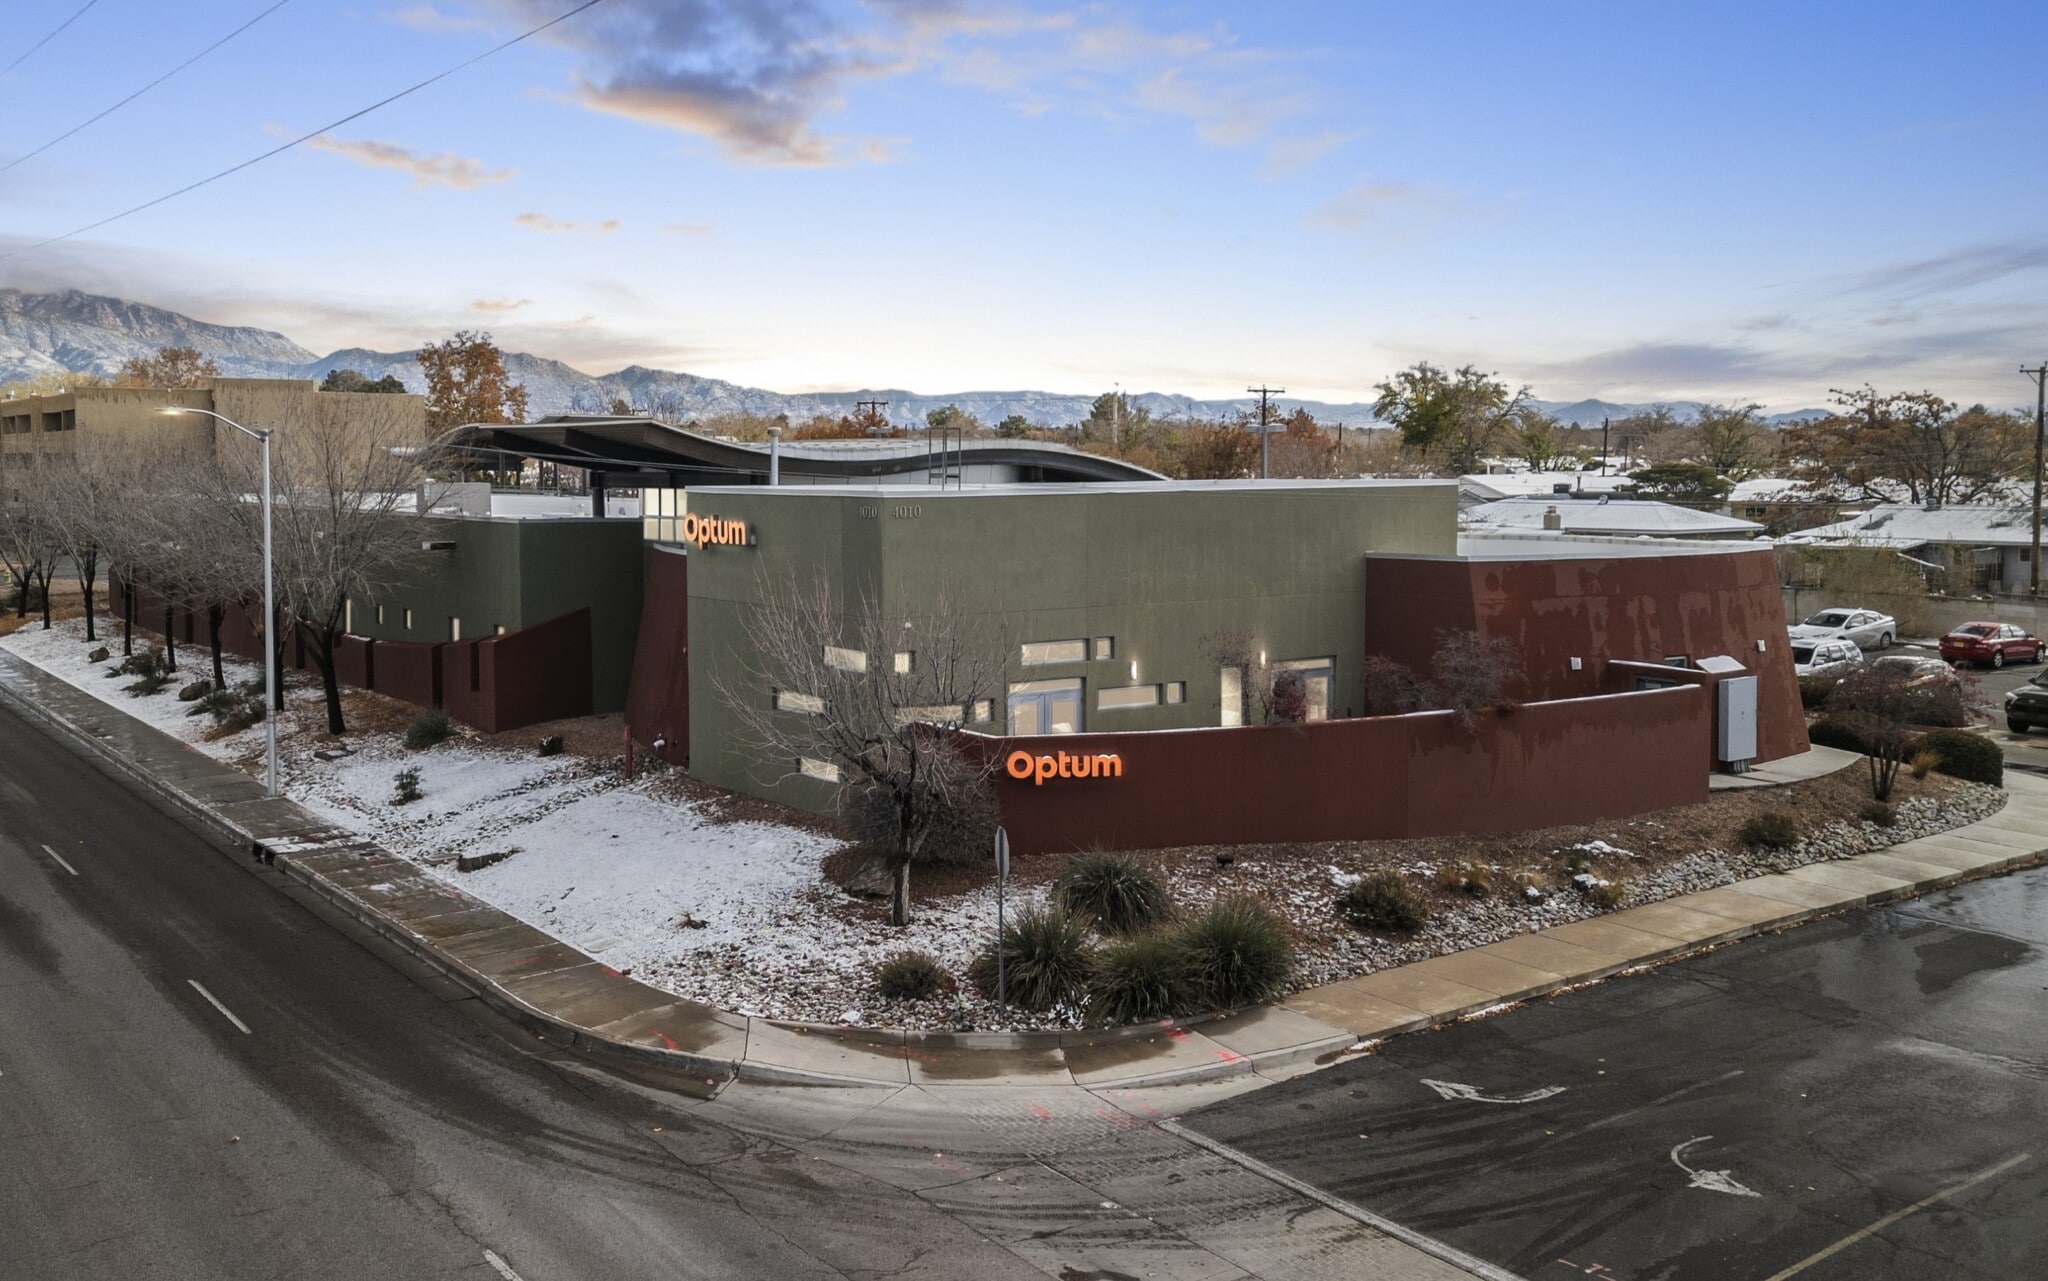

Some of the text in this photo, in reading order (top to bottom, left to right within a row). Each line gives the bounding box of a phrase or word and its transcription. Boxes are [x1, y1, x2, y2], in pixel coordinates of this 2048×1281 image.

[892, 504, 922, 519] 4010
[684, 511, 747, 551] Optum
[1007, 750, 1122, 786] Optum
